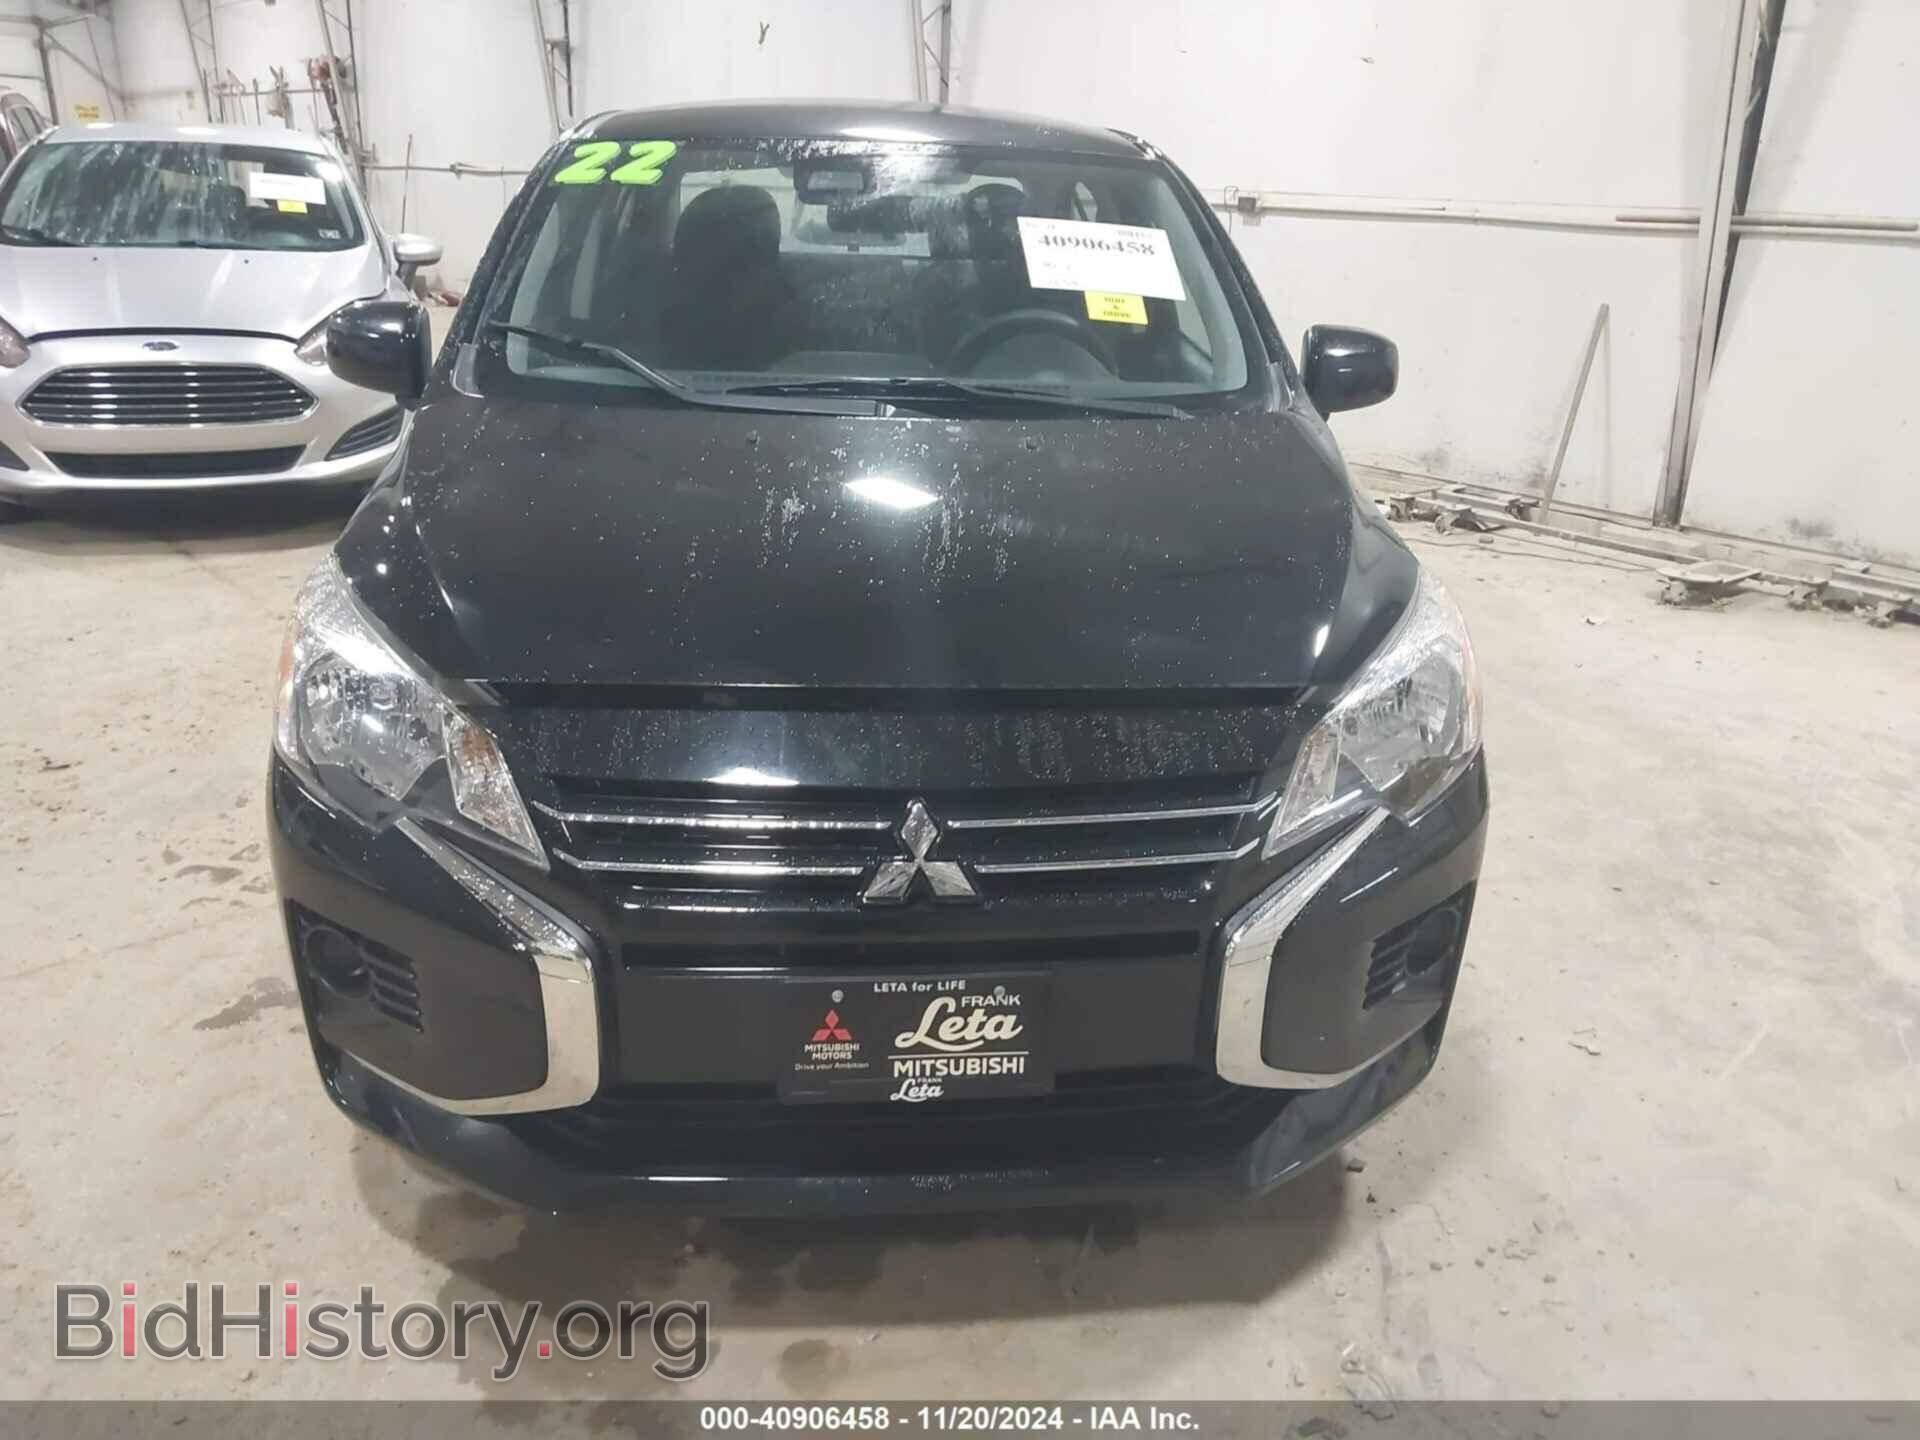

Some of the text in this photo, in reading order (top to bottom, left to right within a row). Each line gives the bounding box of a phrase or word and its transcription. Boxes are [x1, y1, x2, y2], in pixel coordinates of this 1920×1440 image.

[555, 141, 677, 184] 22
[1039, 234, 1155, 255] 40906458
[874, 980, 966, 993] LETA for LIFE
[961, 994, 1021, 1008] FRANK
[895, 996, 1023, 1051] Leta
[804, 1043, 860, 1052] MITSUBISHI
[812, 1052, 852, 1060] MOTORS
[795, 1063, 814, 1071] Drive
[894, 1057, 1025, 1078] MITSUBISHI
[890, 1079, 944, 1102] Leta
